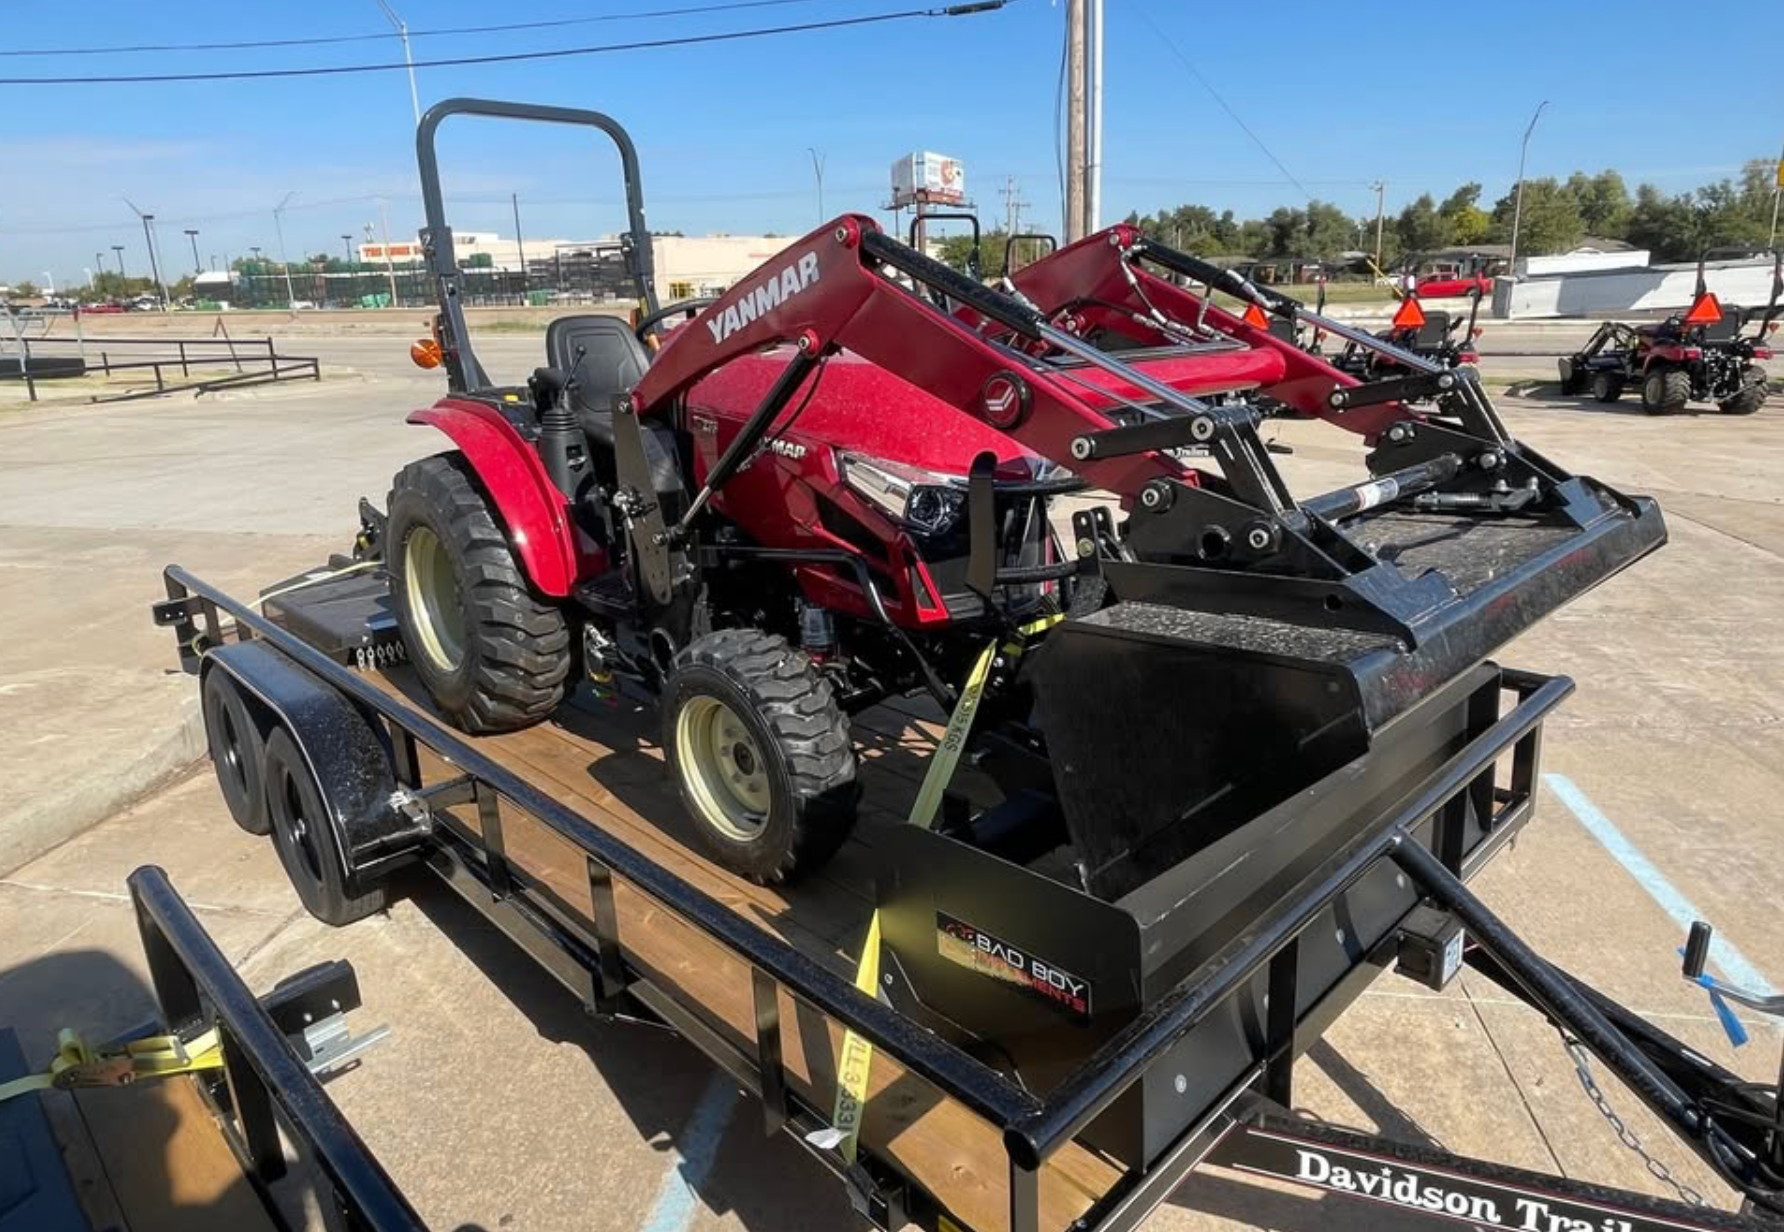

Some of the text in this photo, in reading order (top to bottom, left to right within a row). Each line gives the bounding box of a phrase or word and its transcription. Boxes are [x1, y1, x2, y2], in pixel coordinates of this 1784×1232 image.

[706, 251, 820, 344] YANMAR
[976, 933, 1084, 997] BAD BOY
[1297, 1150, 1501, 1223] Davidson
